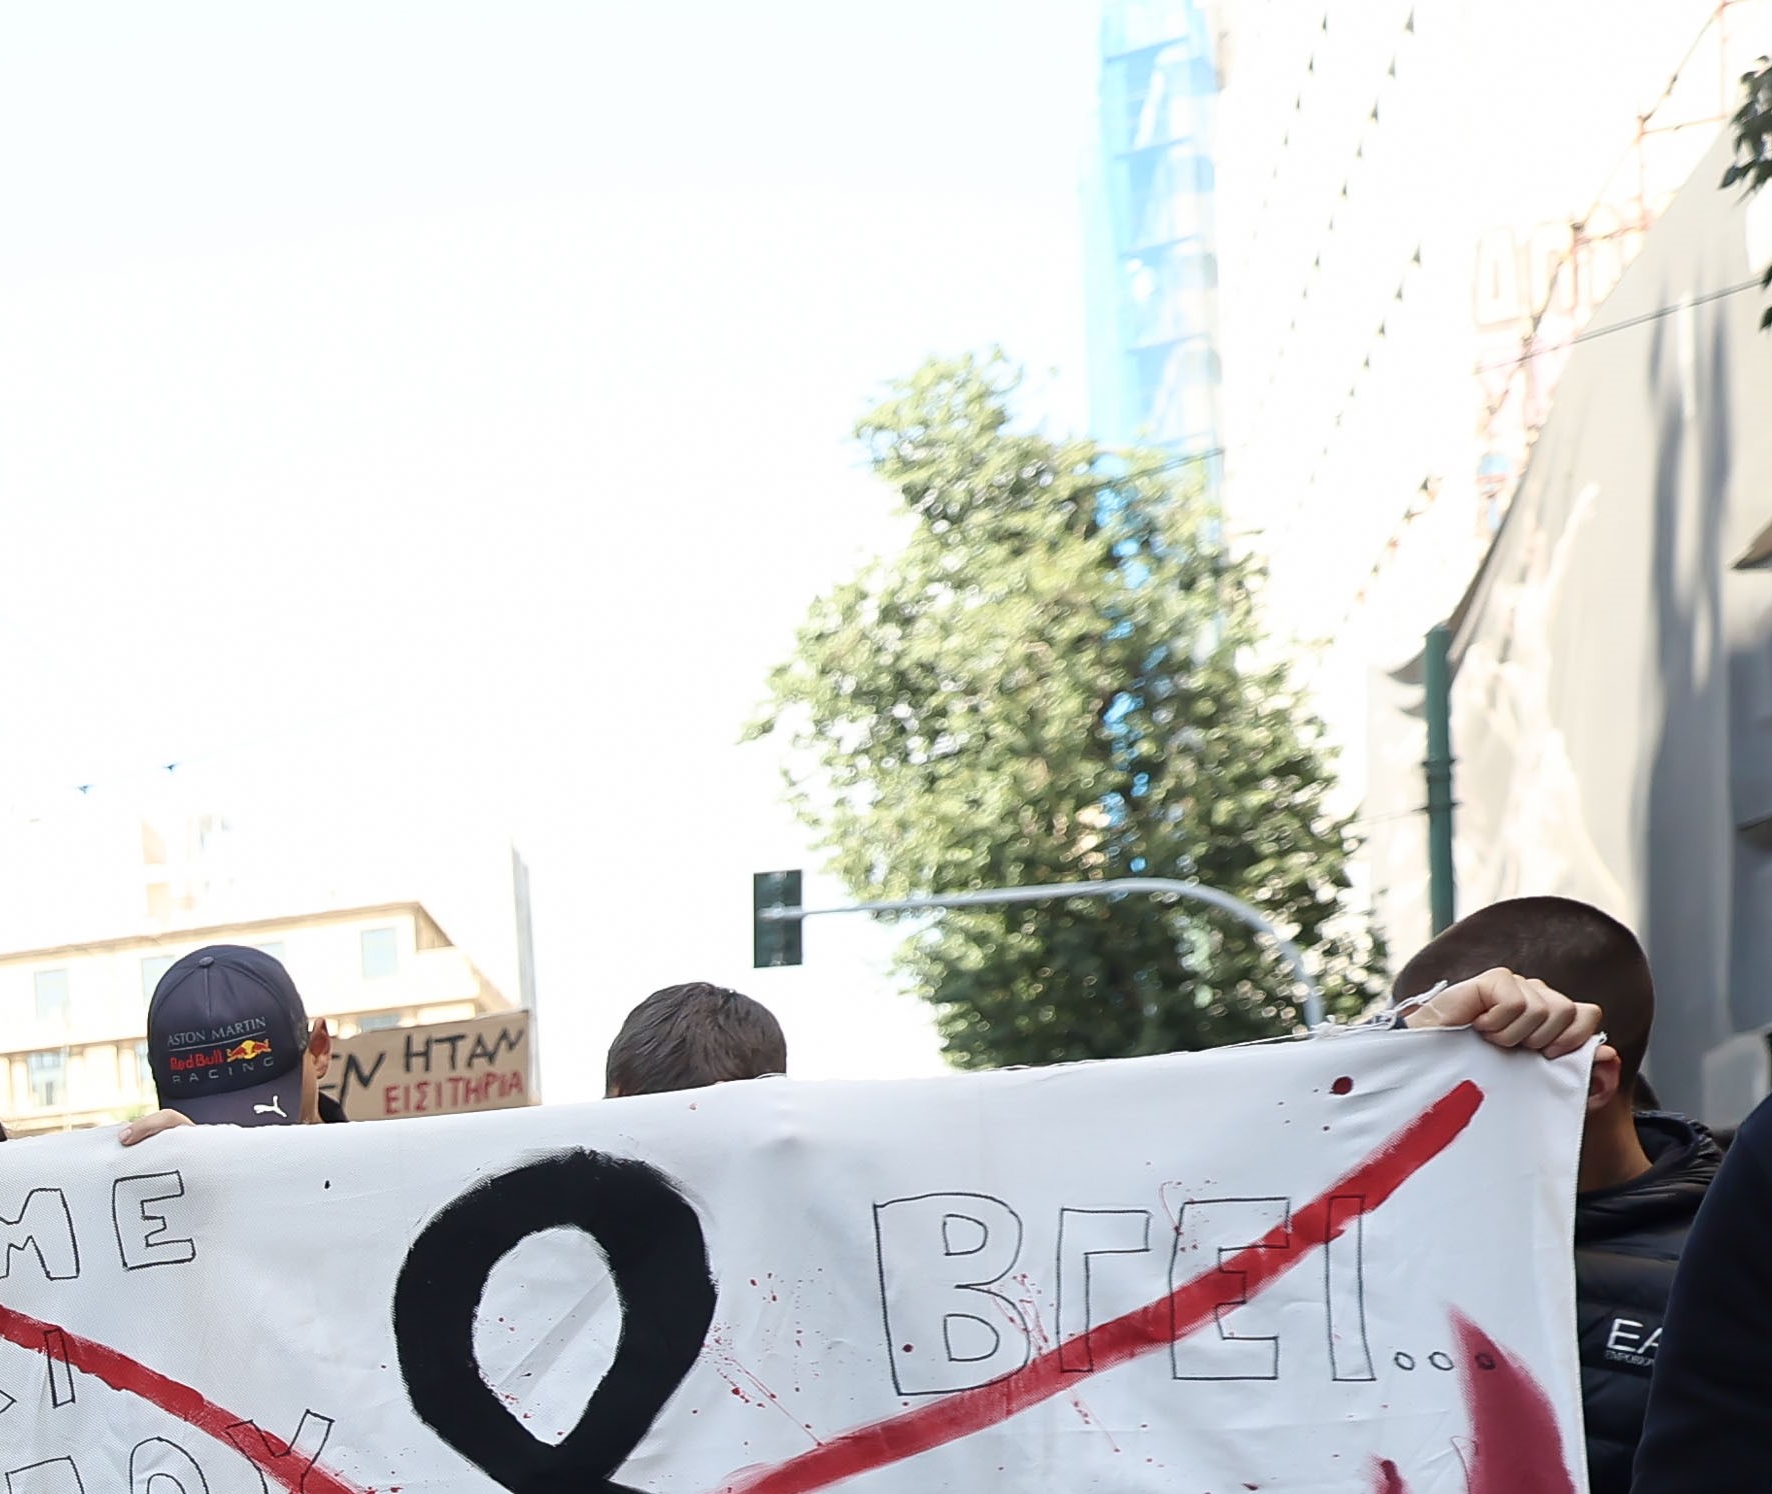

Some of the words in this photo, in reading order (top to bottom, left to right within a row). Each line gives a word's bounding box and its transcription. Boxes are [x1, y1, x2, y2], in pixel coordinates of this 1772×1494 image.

[168, 1030, 206, 1047] ASTON
[211, 1016, 266, 1039] MARTIN
[404, 1027, 525, 1073] ΗΤΑΝ
[171, 1056, 274, 1083] RACING
[384, 1071, 523, 1116] ΕΙΣΙΤΗΡΙΑ
